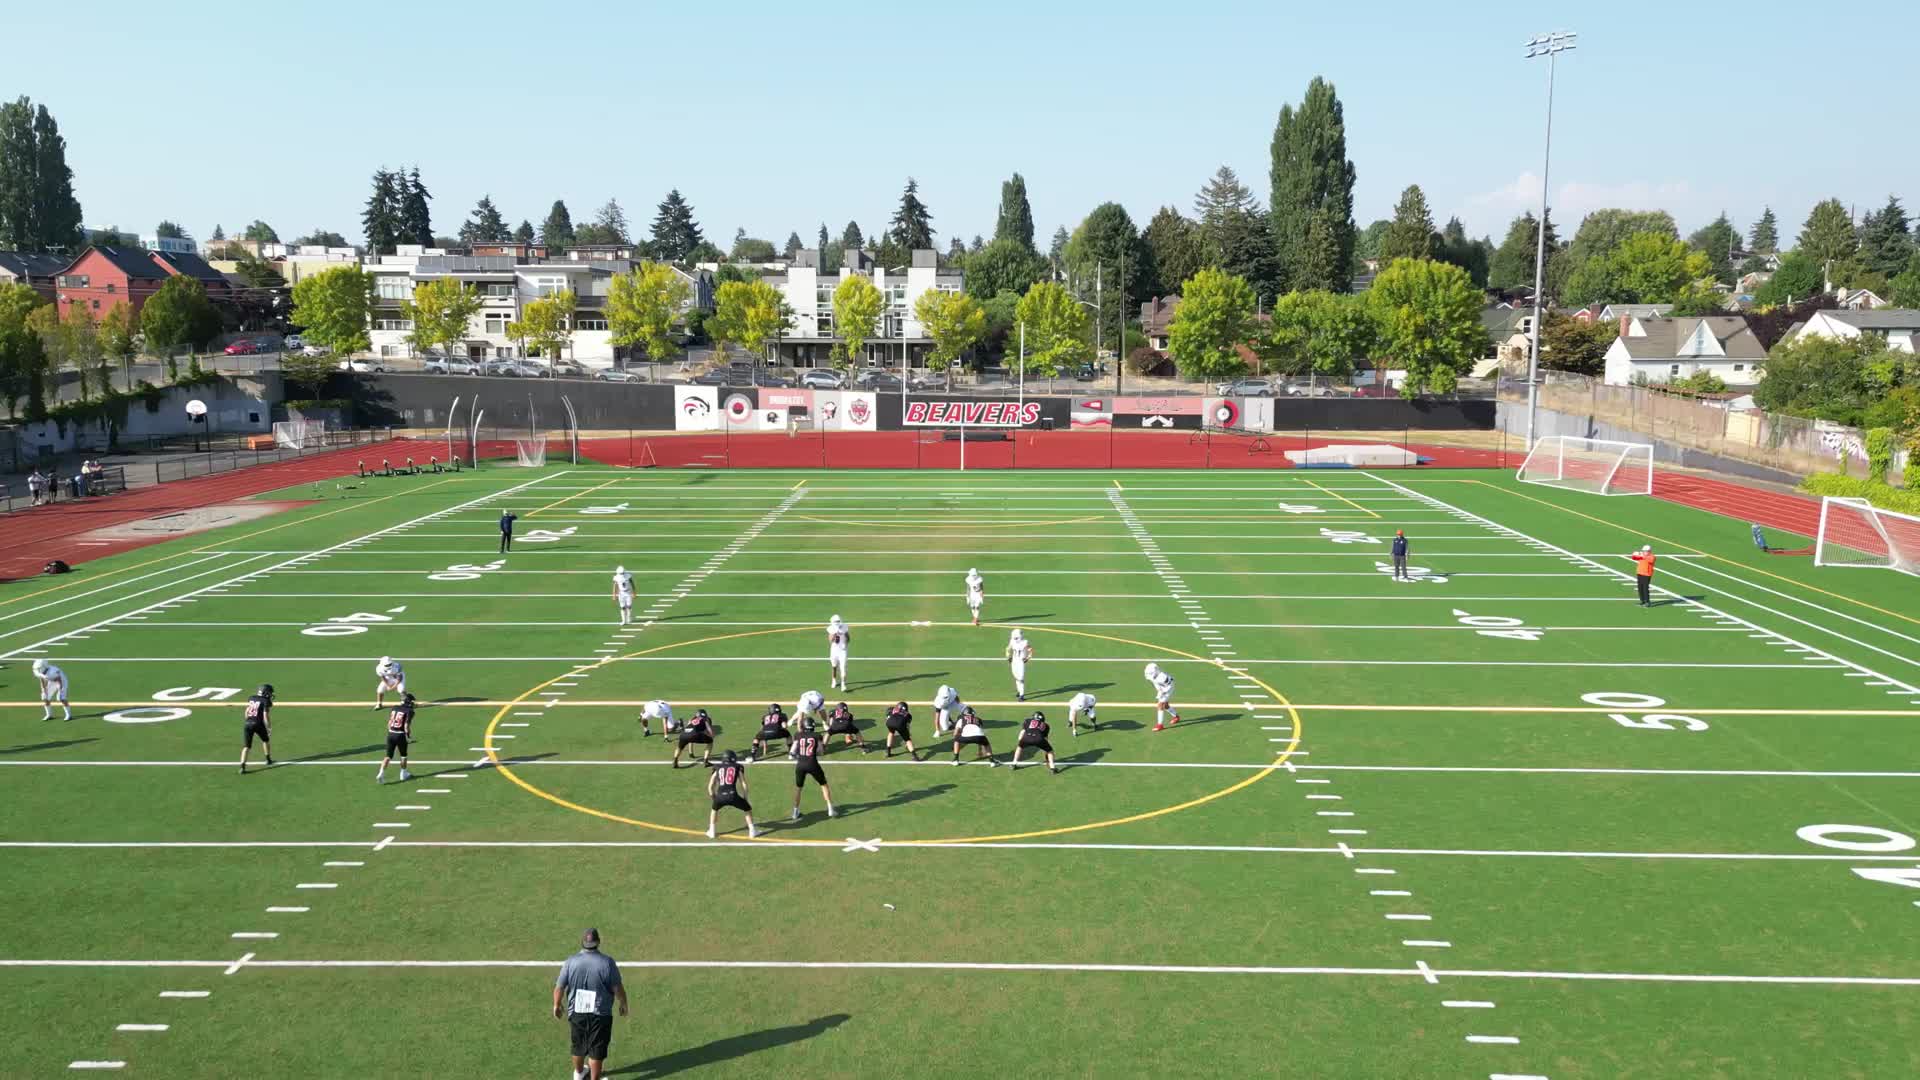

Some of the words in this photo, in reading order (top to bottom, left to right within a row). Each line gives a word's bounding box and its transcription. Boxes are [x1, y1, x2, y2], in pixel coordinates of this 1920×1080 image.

[905, 402, 1041, 425] BEAVERS
[514, 529, 576, 543] 20
[1320, 531, 1383, 544] 20
[427, 563, 502, 581] 30
[300, 612, 393, 636] 40
[1457, 616, 1544, 641] 40
[102, 686, 242, 724] 50
[1580, 692, 1709, 731] 50
[799, 737, 816, 757] 12
[718, 766, 736, 786] 18
